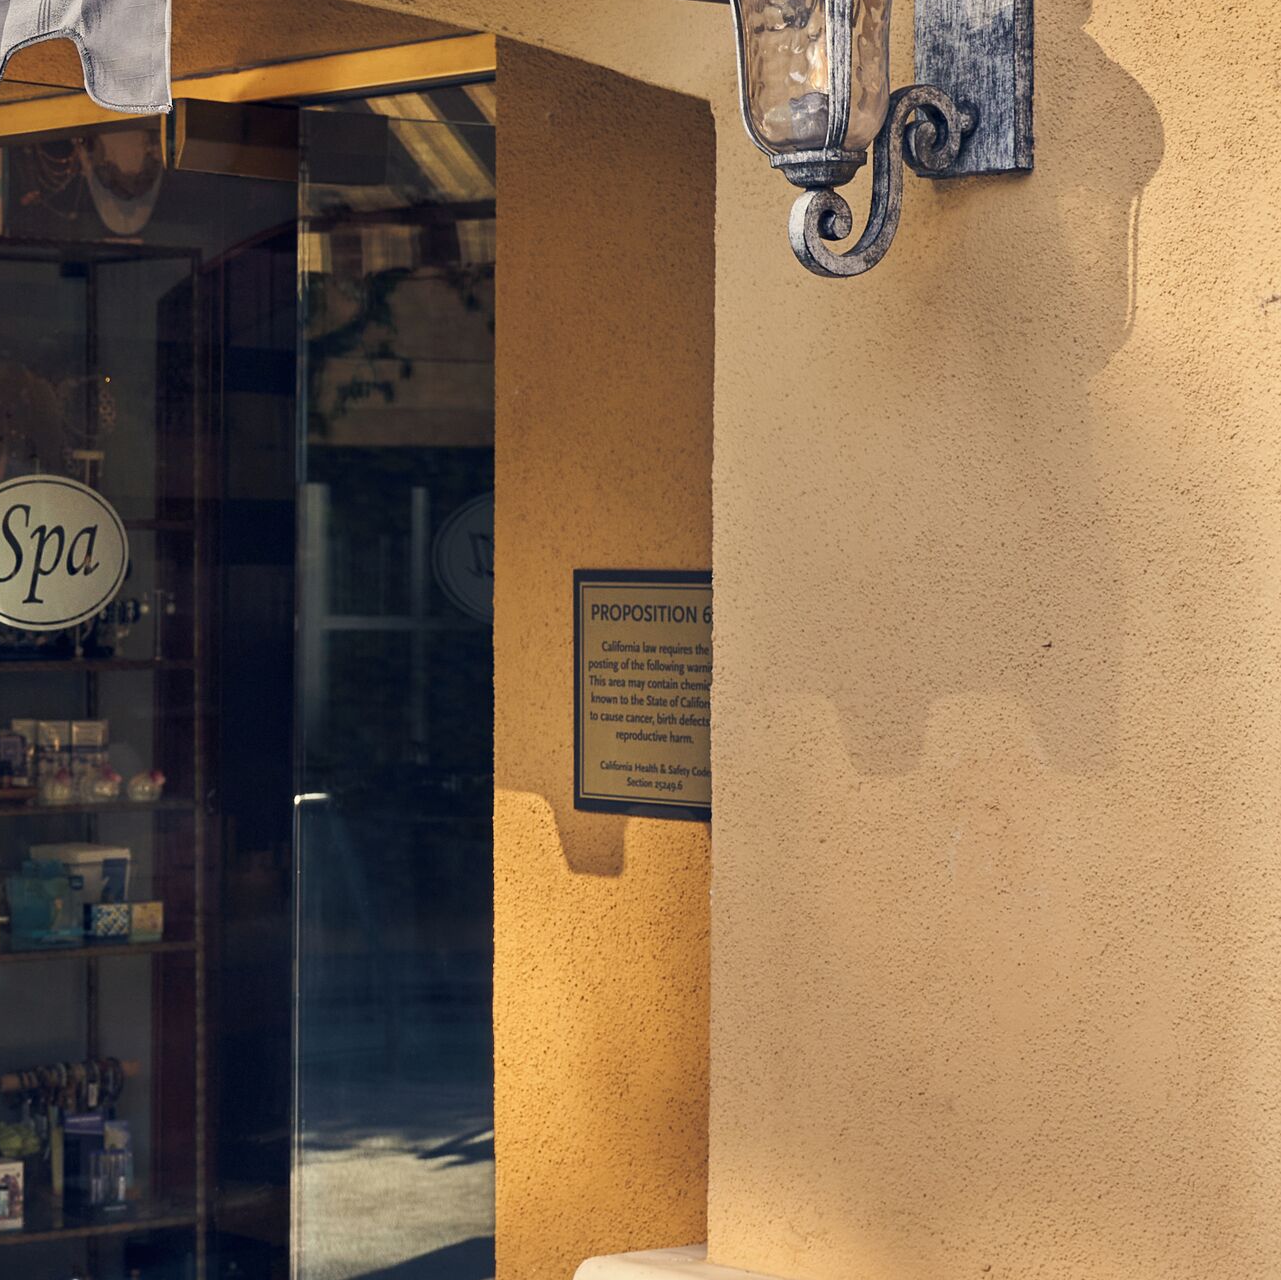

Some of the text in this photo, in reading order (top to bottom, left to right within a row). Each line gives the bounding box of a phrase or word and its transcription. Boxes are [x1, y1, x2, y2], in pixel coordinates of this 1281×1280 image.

[591, 604, 697, 623] PROPOSITION
[601, 640, 709, 656] California law requires the
[588, 658, 618, 672] posting
[621, 658, 630, 670] of
[631, 659, 644, 670] the
[647, 659, 684, 675] following
[589, 675, 606, 687] This
[608, 678, 625, 688] area
[628, 679, 645, 691] may
[647, 679, 678, 690] contain
[591, 692, 618, 704] known
[620, 695, 628, 705] to
[631, 695, 644, 706] the
[646, 695, 668, 707] State
[669, 696, 680, 707] of
[590, 711, 598, 721] to
[600, 712, 624, 722] cause
[625, 714, 655, 725] cancer,
[657, 713, 677, 725] birth
[616, 730, 694, 744] reproductive harm.
[600, 761, 632, 771] California
[634, 763, 658, 774] Health
[668, 765, 690, 778] Safety
[626, 777, 653, 787] Section
